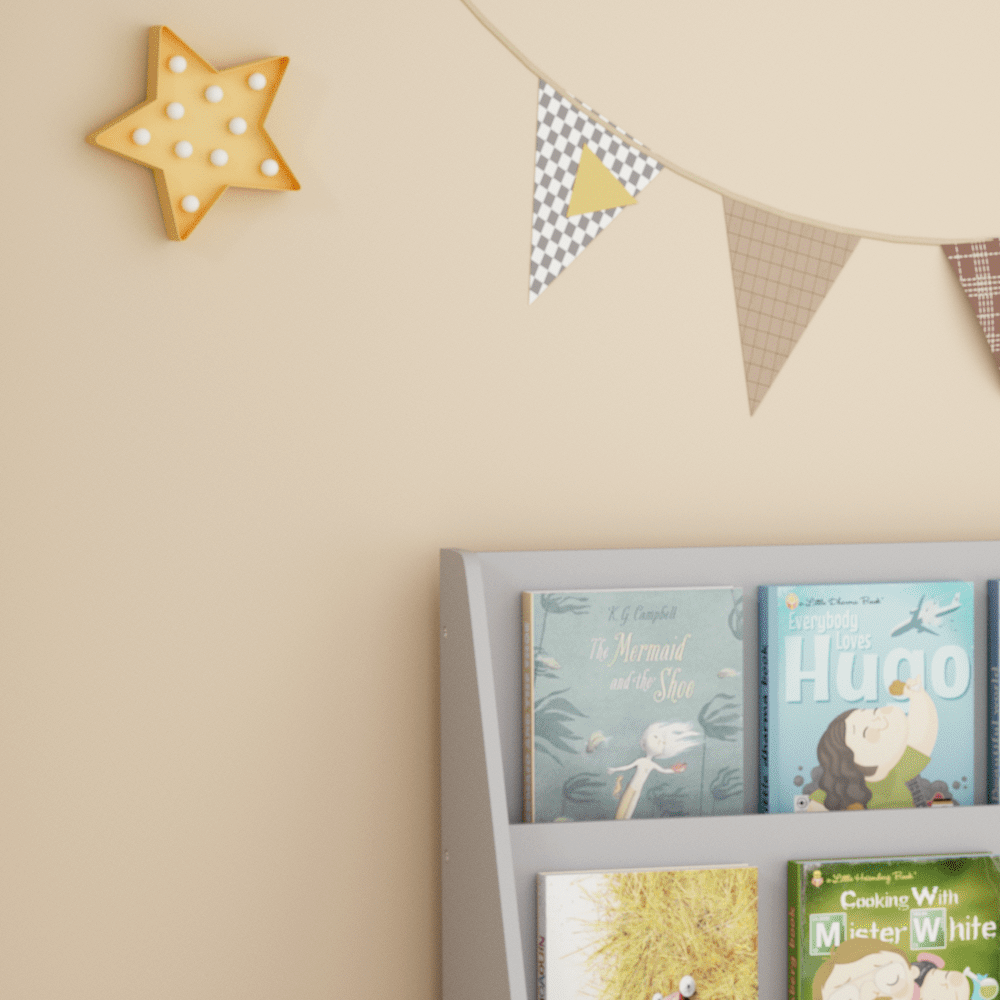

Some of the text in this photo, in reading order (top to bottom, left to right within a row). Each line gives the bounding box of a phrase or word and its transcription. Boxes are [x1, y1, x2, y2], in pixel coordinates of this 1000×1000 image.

[788, 610, 859, 634] Everybody
[590, 632, 691, 667] The Mermaid
[836, 631, 873, 651] Loves
[610, 667, 695, 703] and the Shoe
[840, 886, 959, 911] Cooking With
[815, 914, 998, 948] Mister White
